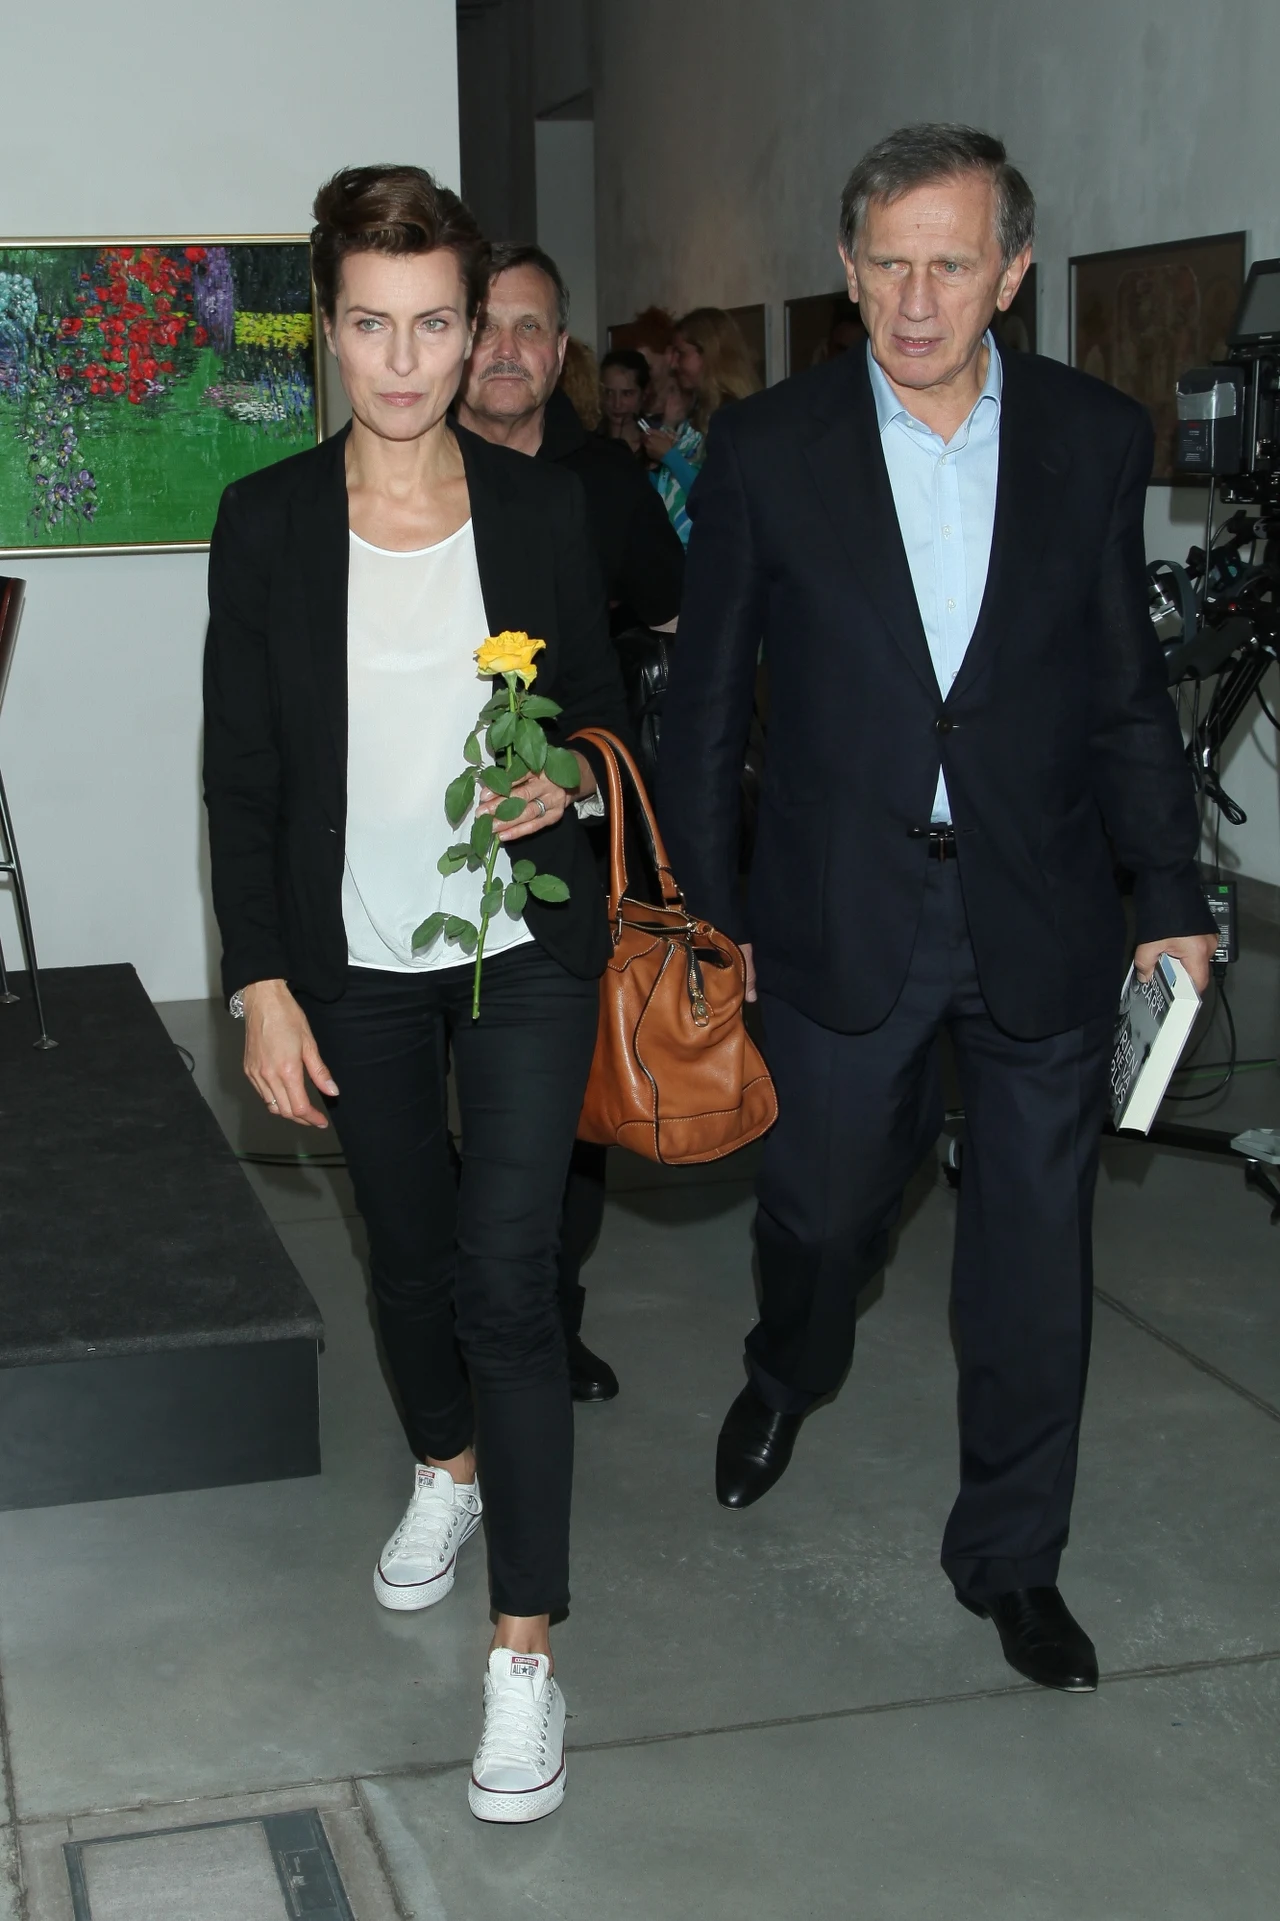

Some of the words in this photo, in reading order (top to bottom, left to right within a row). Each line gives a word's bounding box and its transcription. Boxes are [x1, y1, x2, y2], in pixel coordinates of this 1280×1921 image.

[1114, 1045, 1125, 1070] NE
[1122, 1064, 1131, 1089] VA
[1120, 1030, 1139, 1075] RIEN
[512, 1664, 521, 1675] ALL
